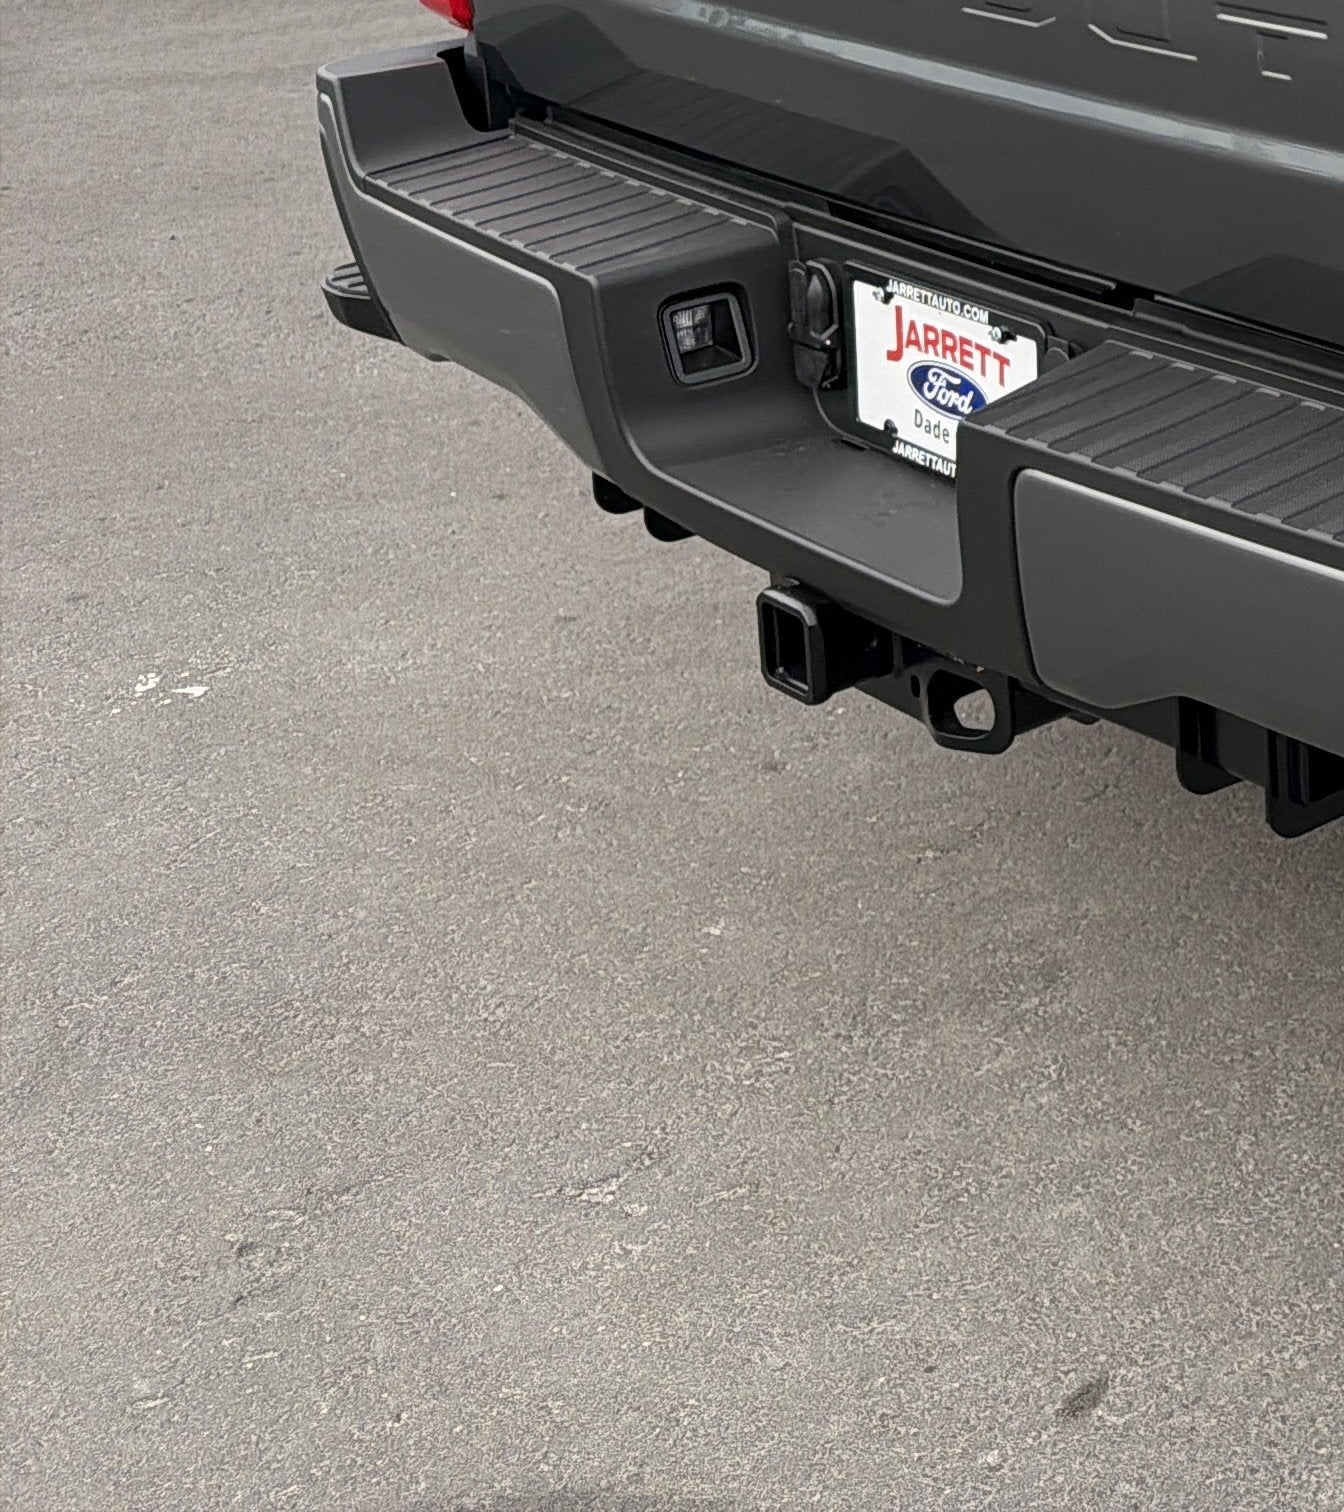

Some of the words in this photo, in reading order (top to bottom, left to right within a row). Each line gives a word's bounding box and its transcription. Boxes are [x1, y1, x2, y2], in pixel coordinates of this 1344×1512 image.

[885, 278, 989, 325] JARRETTAUTO.COM
[886, 305, 1011, 387] JARRETT
[923, 367, 974, 415] Ford
[913, 408, 950, 444] Dade
[892, 439, 957, 478] JARRETTAUT
